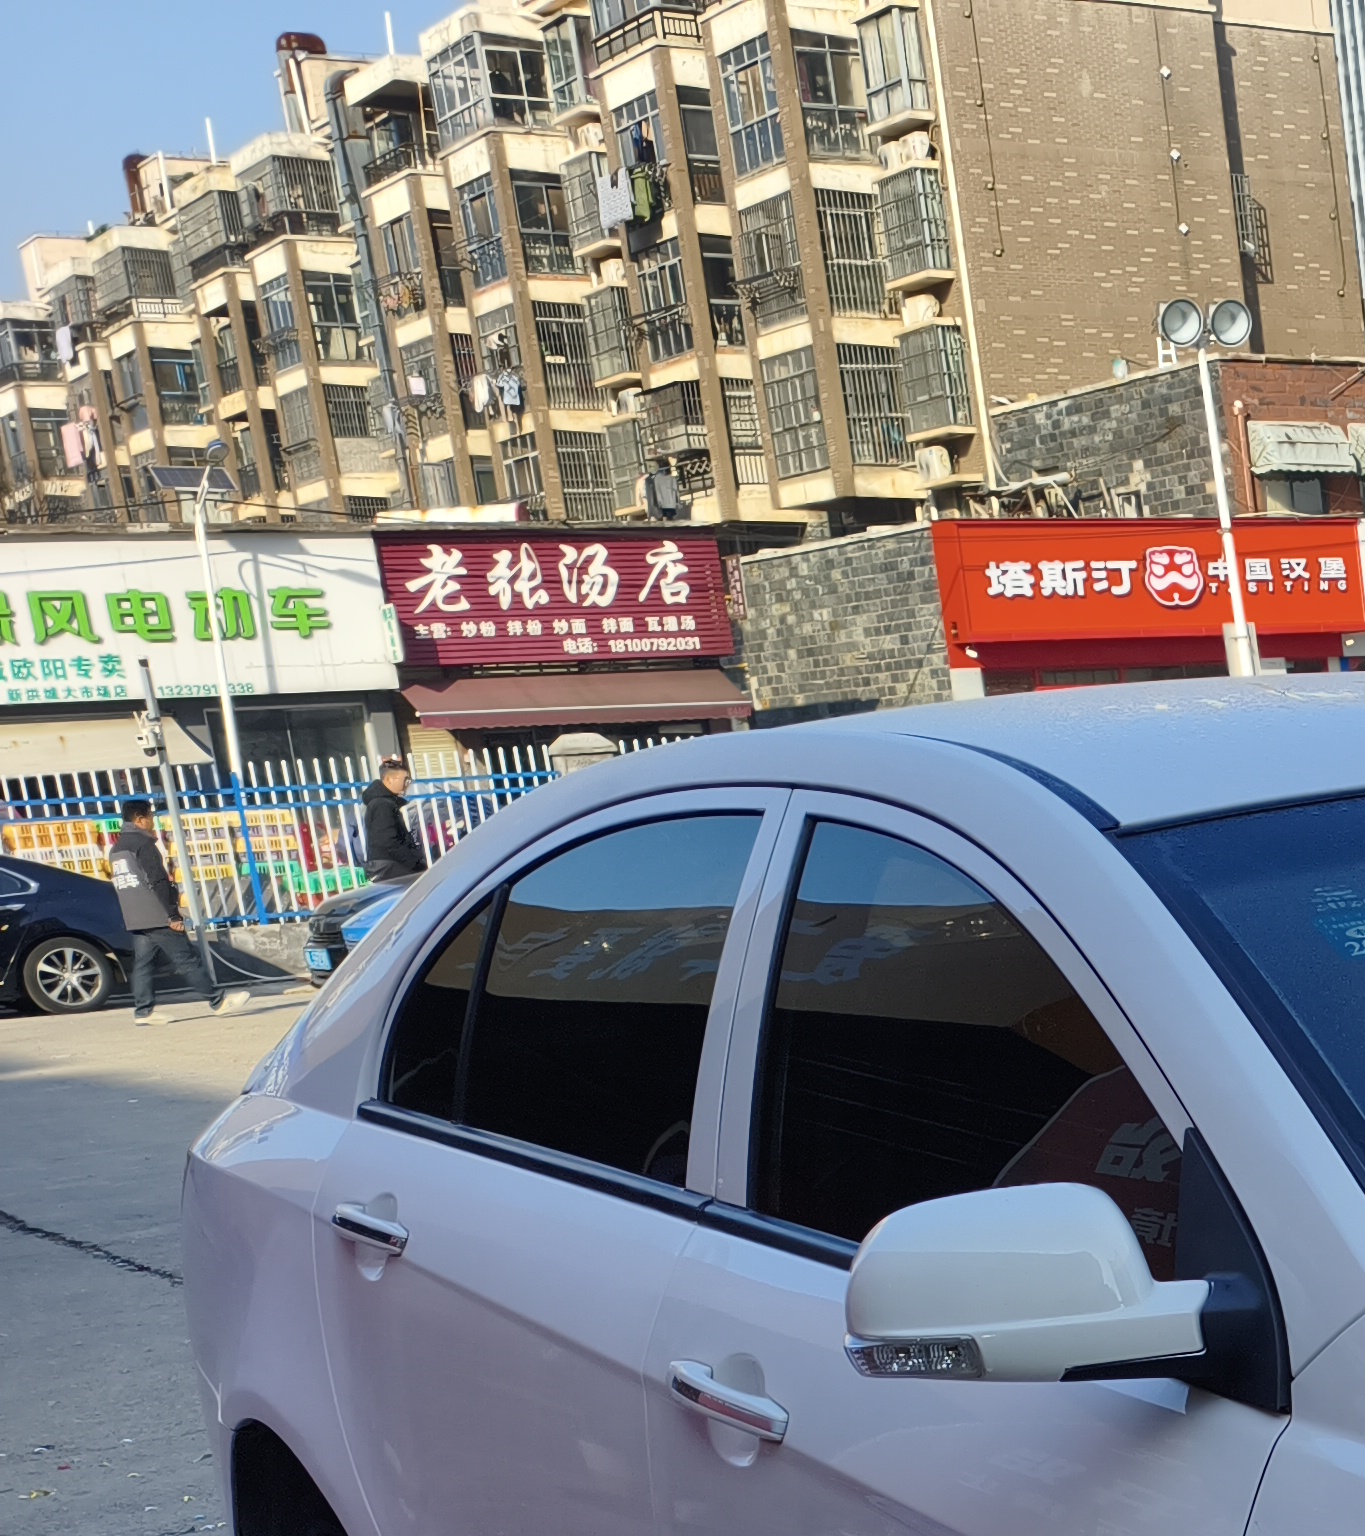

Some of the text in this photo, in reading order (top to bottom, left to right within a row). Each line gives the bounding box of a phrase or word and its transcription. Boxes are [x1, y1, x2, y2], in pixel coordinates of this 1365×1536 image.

[405, 540, 691, 614] 老张汤店
[985, 557, 1347, 597] 塔斯汀 中国汉堡
[1208, 579, 1348, 594] TSITING
[157, 682, 255, 696] 1323791338
